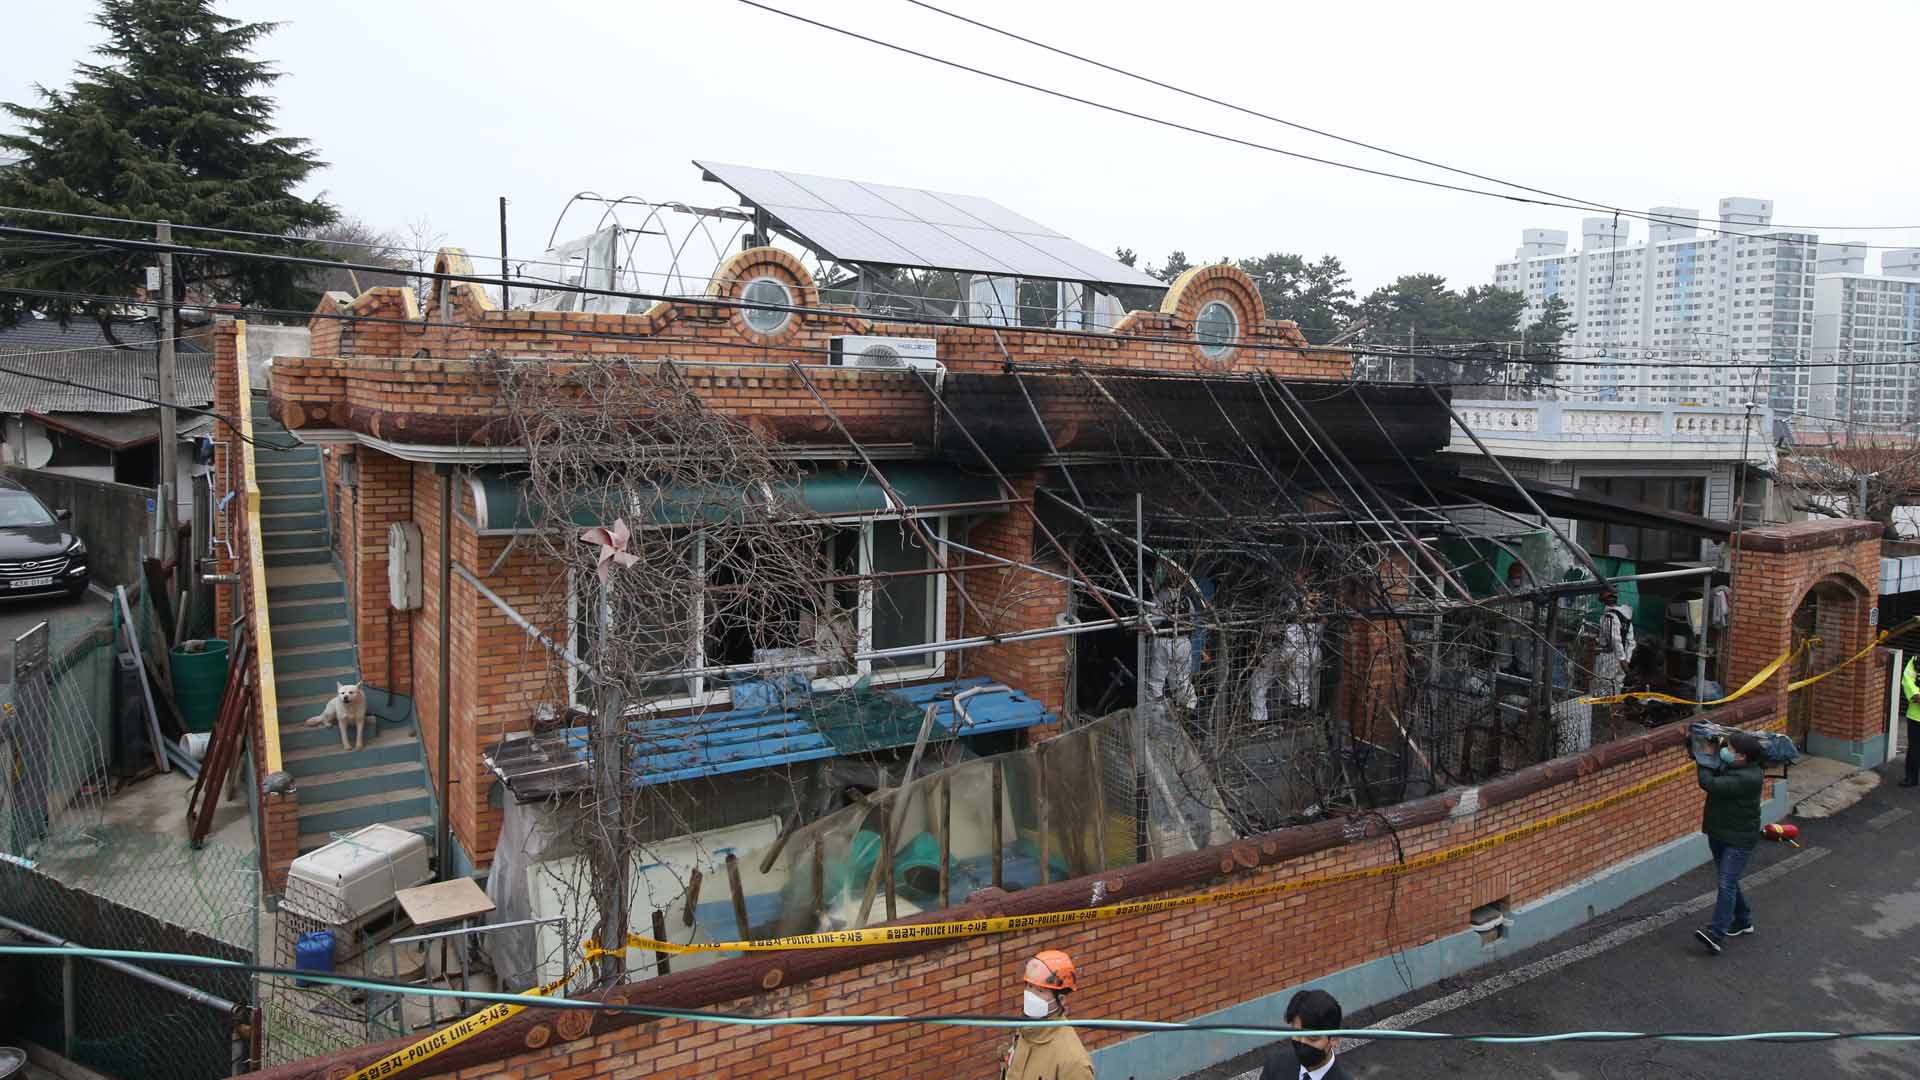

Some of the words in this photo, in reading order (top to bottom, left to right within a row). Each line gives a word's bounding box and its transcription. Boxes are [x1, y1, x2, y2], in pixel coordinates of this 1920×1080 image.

[817, 931, 864, 943] LINE-수사중
[886, 926, 945, 940] 출입금지-POLICE
[948, 922, 988, 935] LINE-수사중
[450, 1004, 510, 1041] LINE-수사중
